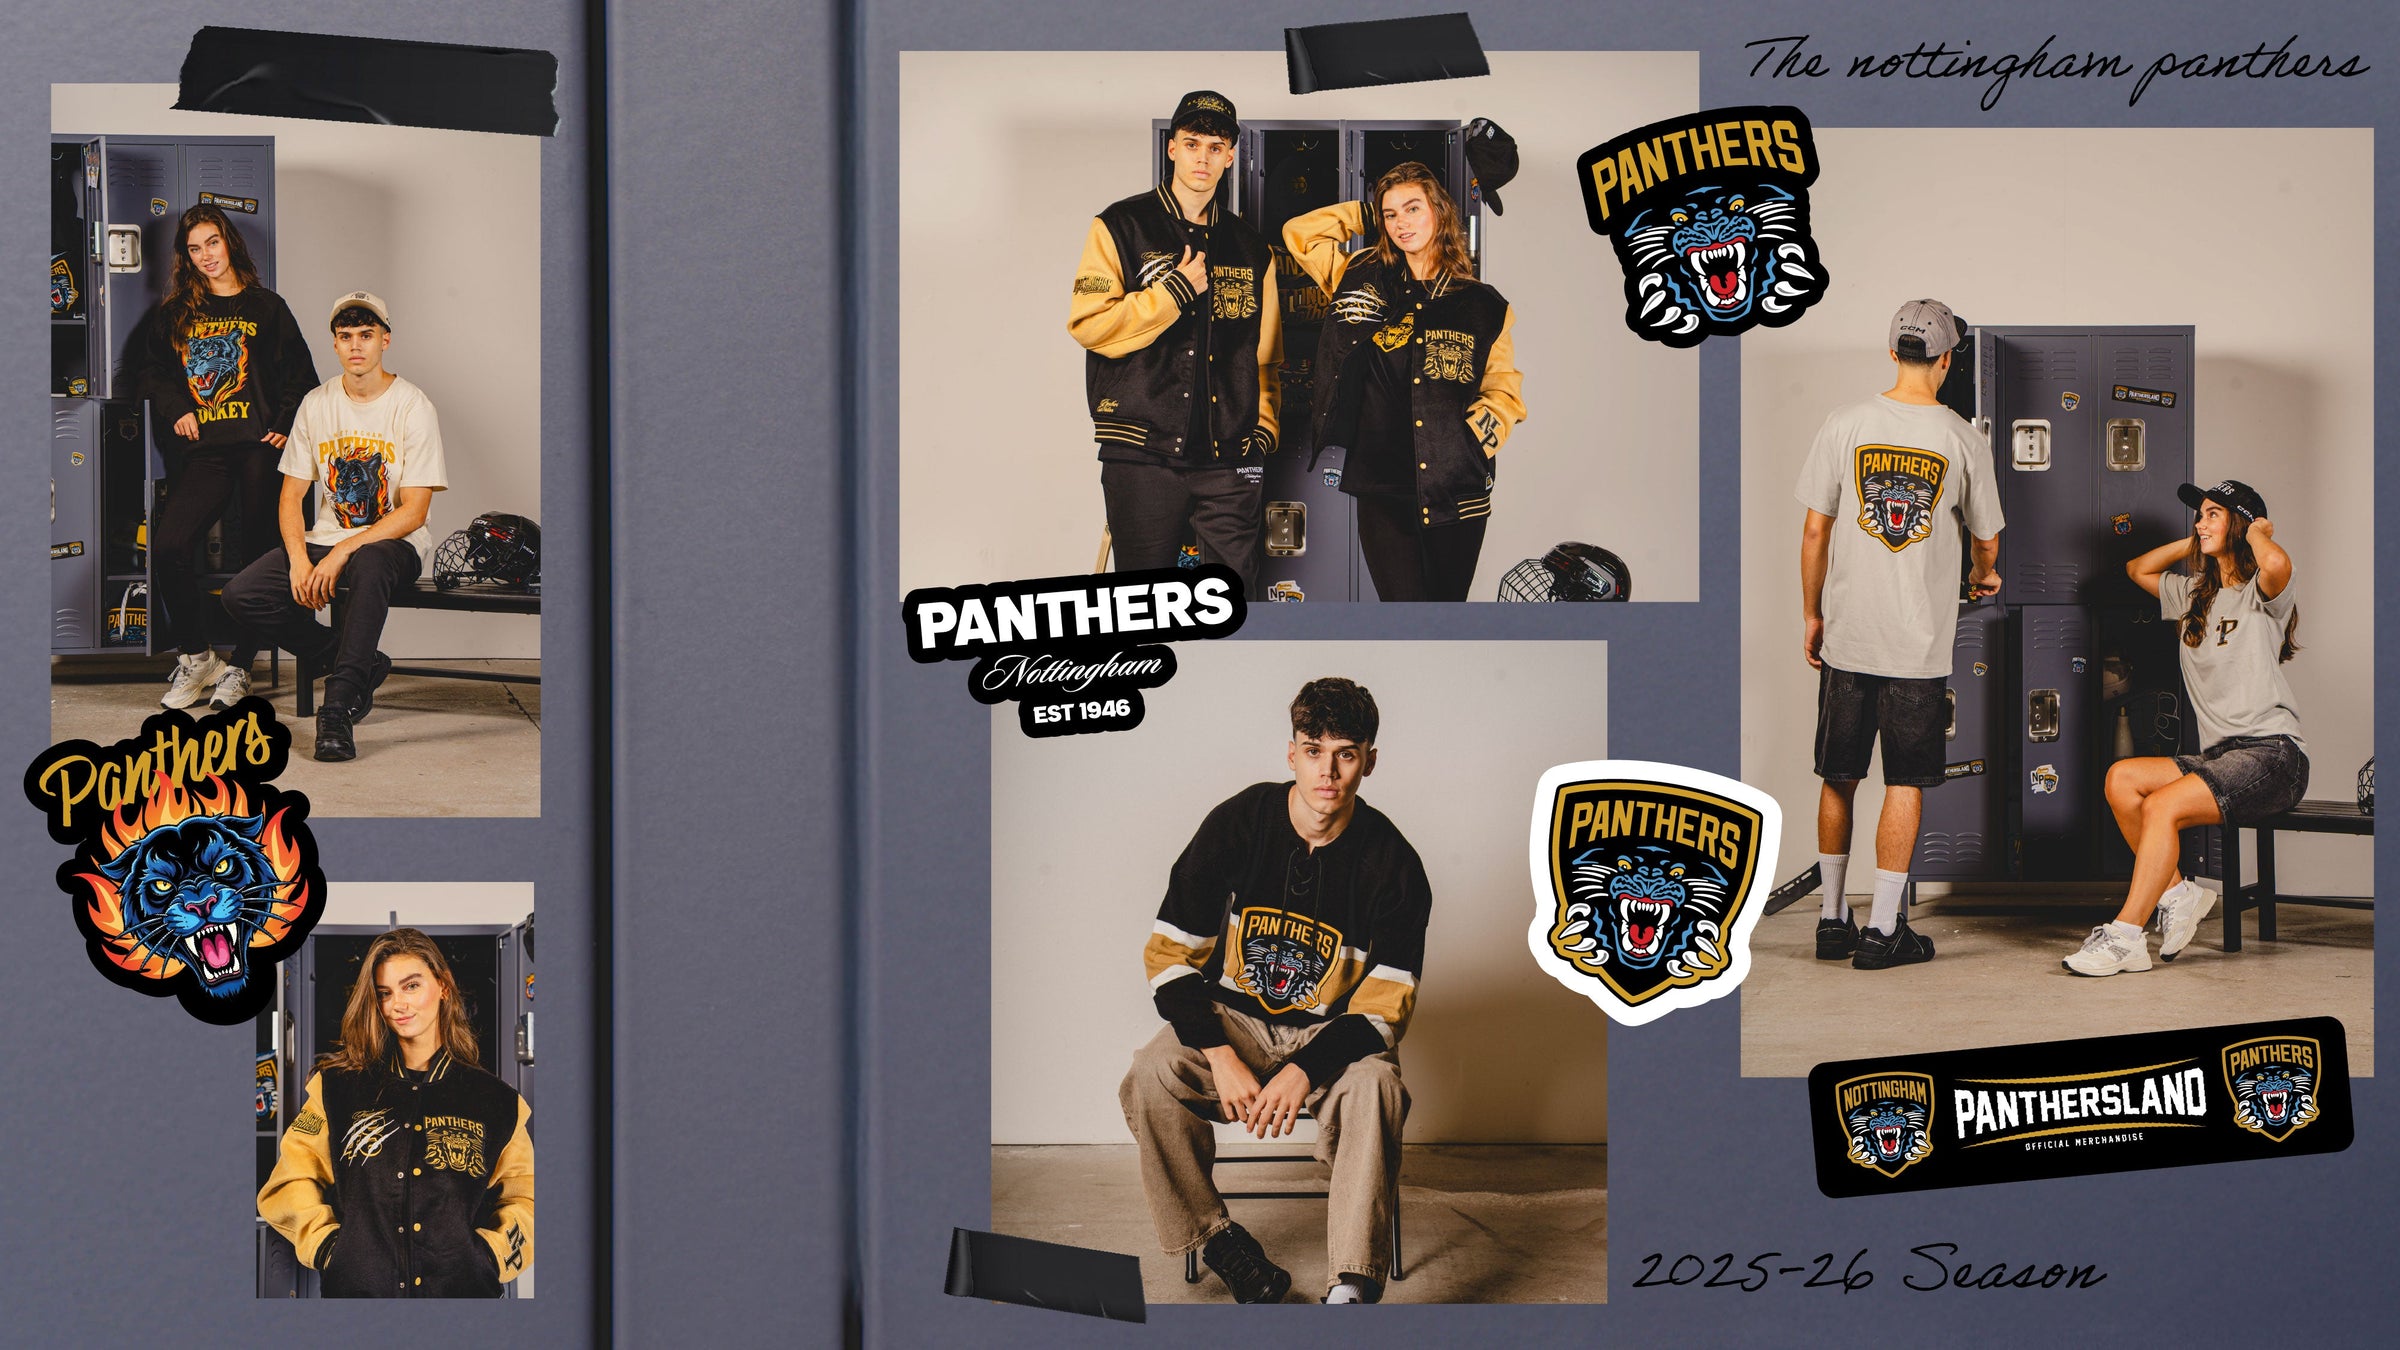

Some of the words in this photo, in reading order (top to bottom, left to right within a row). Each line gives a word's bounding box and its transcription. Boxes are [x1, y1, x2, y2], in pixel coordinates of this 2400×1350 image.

[1425, 329, 1475, 349] PANTHERS
[1862, 452, 1941, 486] PANTHERS
[425, 1115, 484, 1138] PANTHERS
